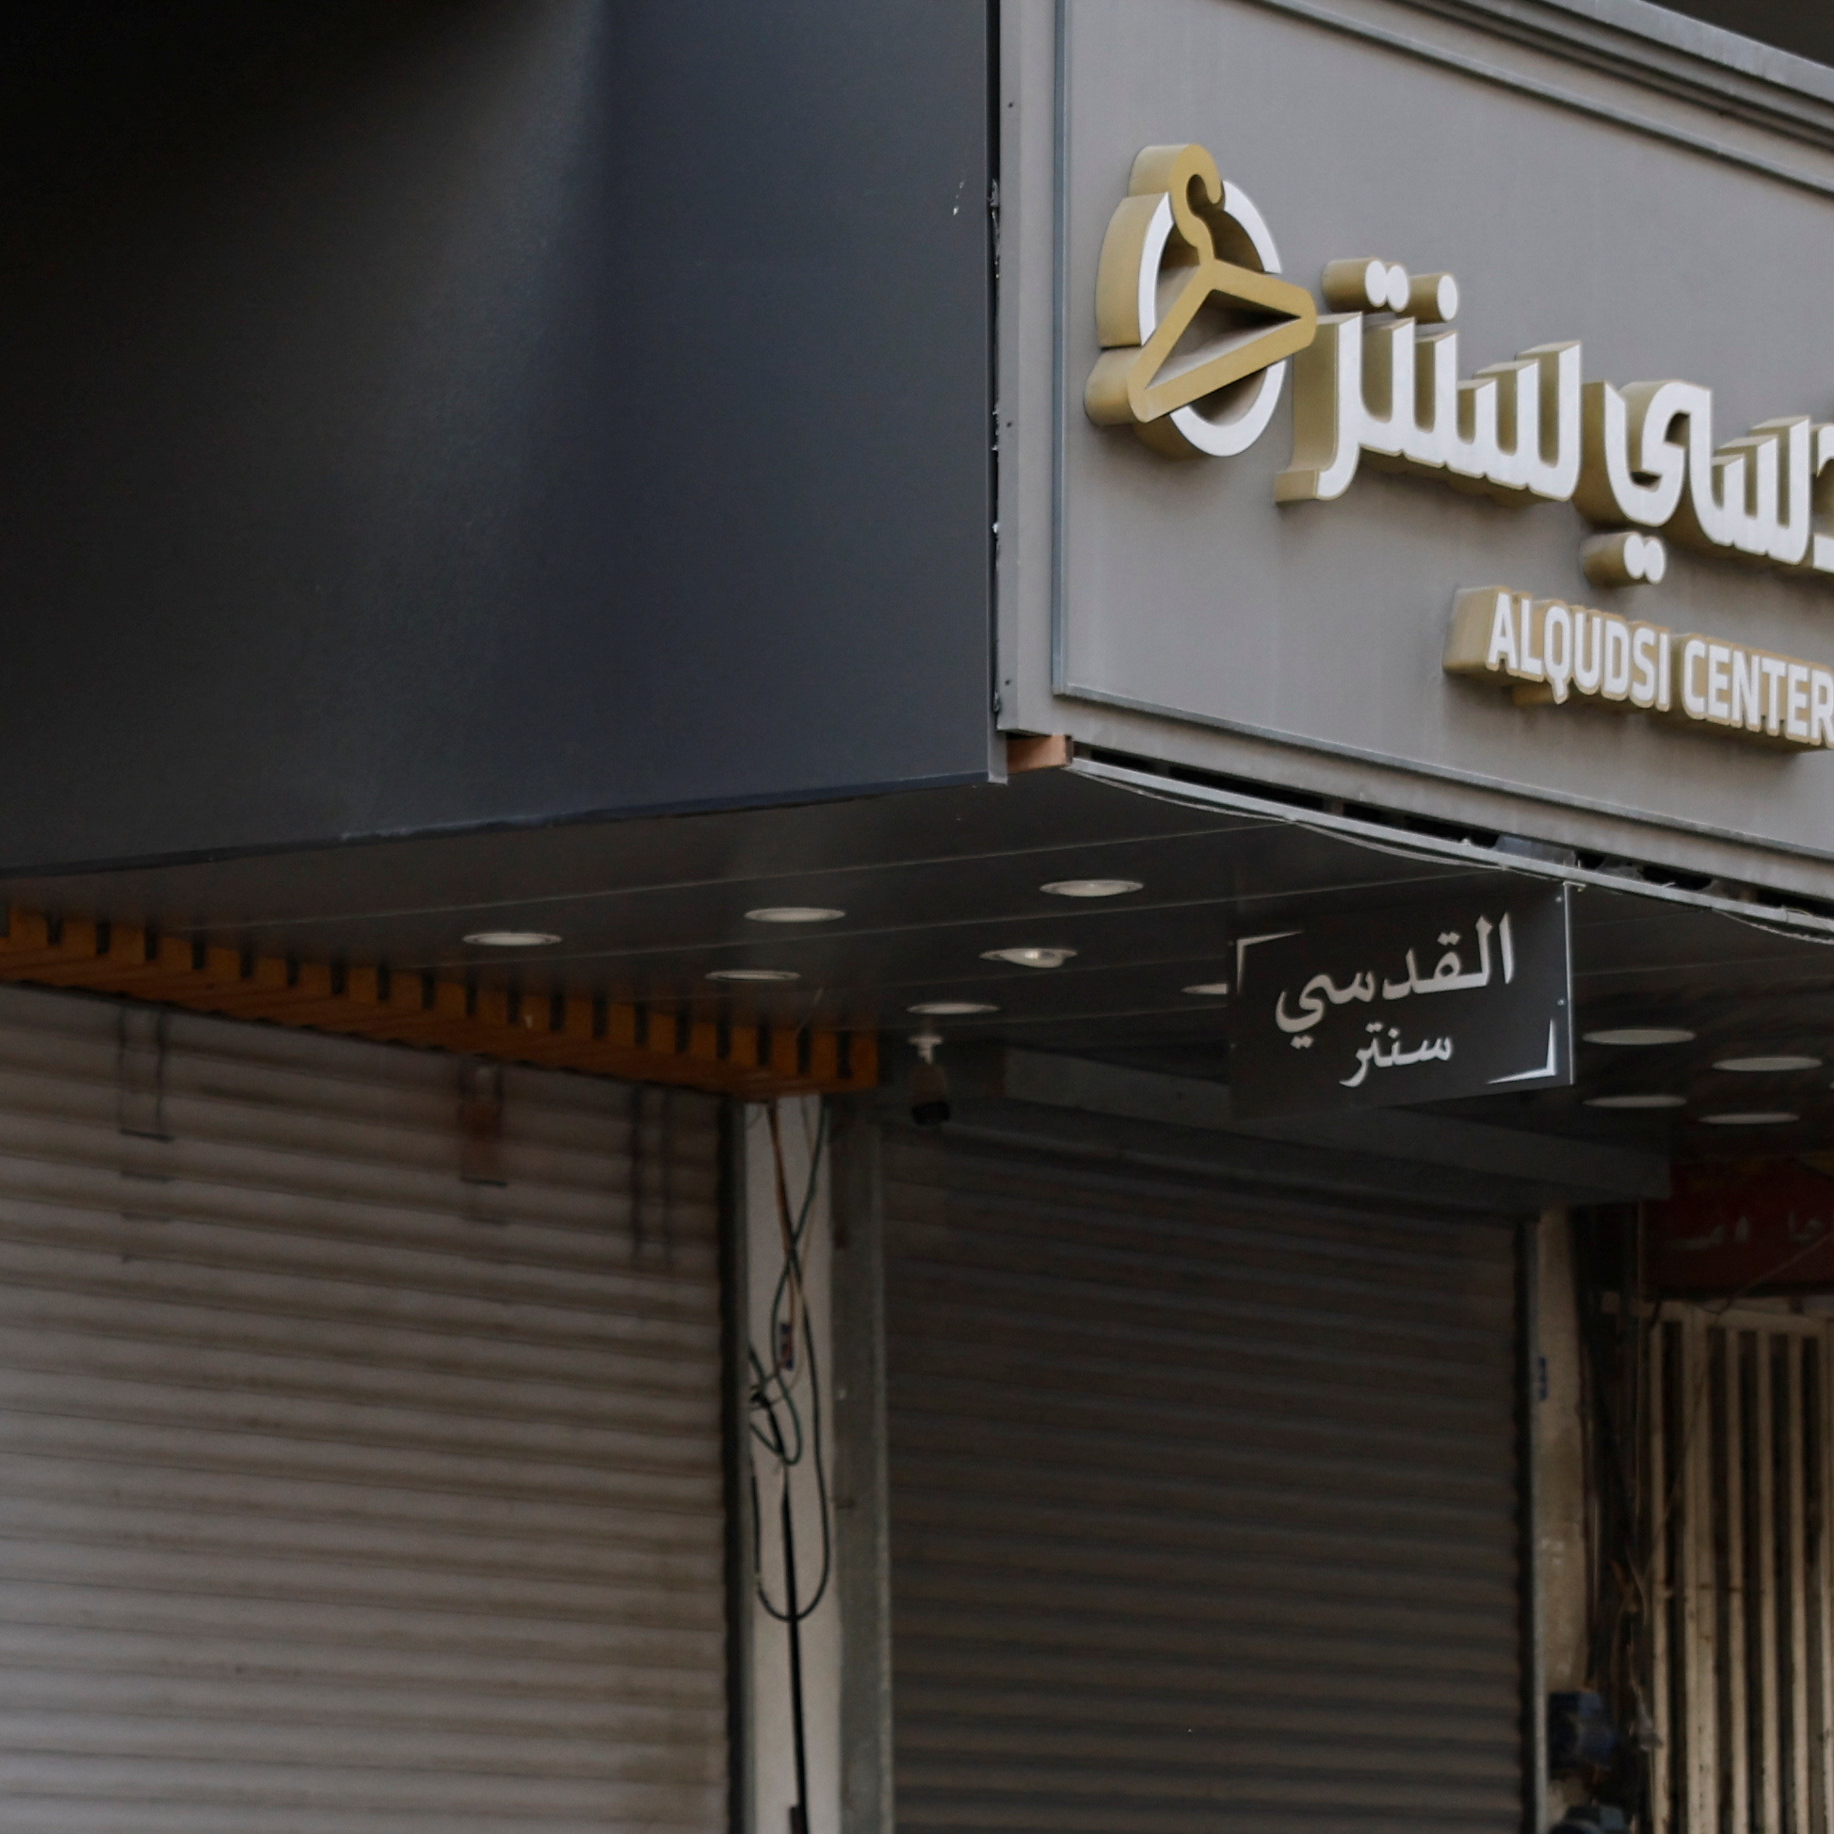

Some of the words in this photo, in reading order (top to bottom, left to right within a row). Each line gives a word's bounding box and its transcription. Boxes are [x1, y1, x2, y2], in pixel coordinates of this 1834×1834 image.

[1316, 260, 1581, 501] سنتر
[1485, 590, 1671, 712] ALQUDSI
[1275, 911, 1515, 1051] القدسي
[1338, 1020, 1455, 1089] سنتر
